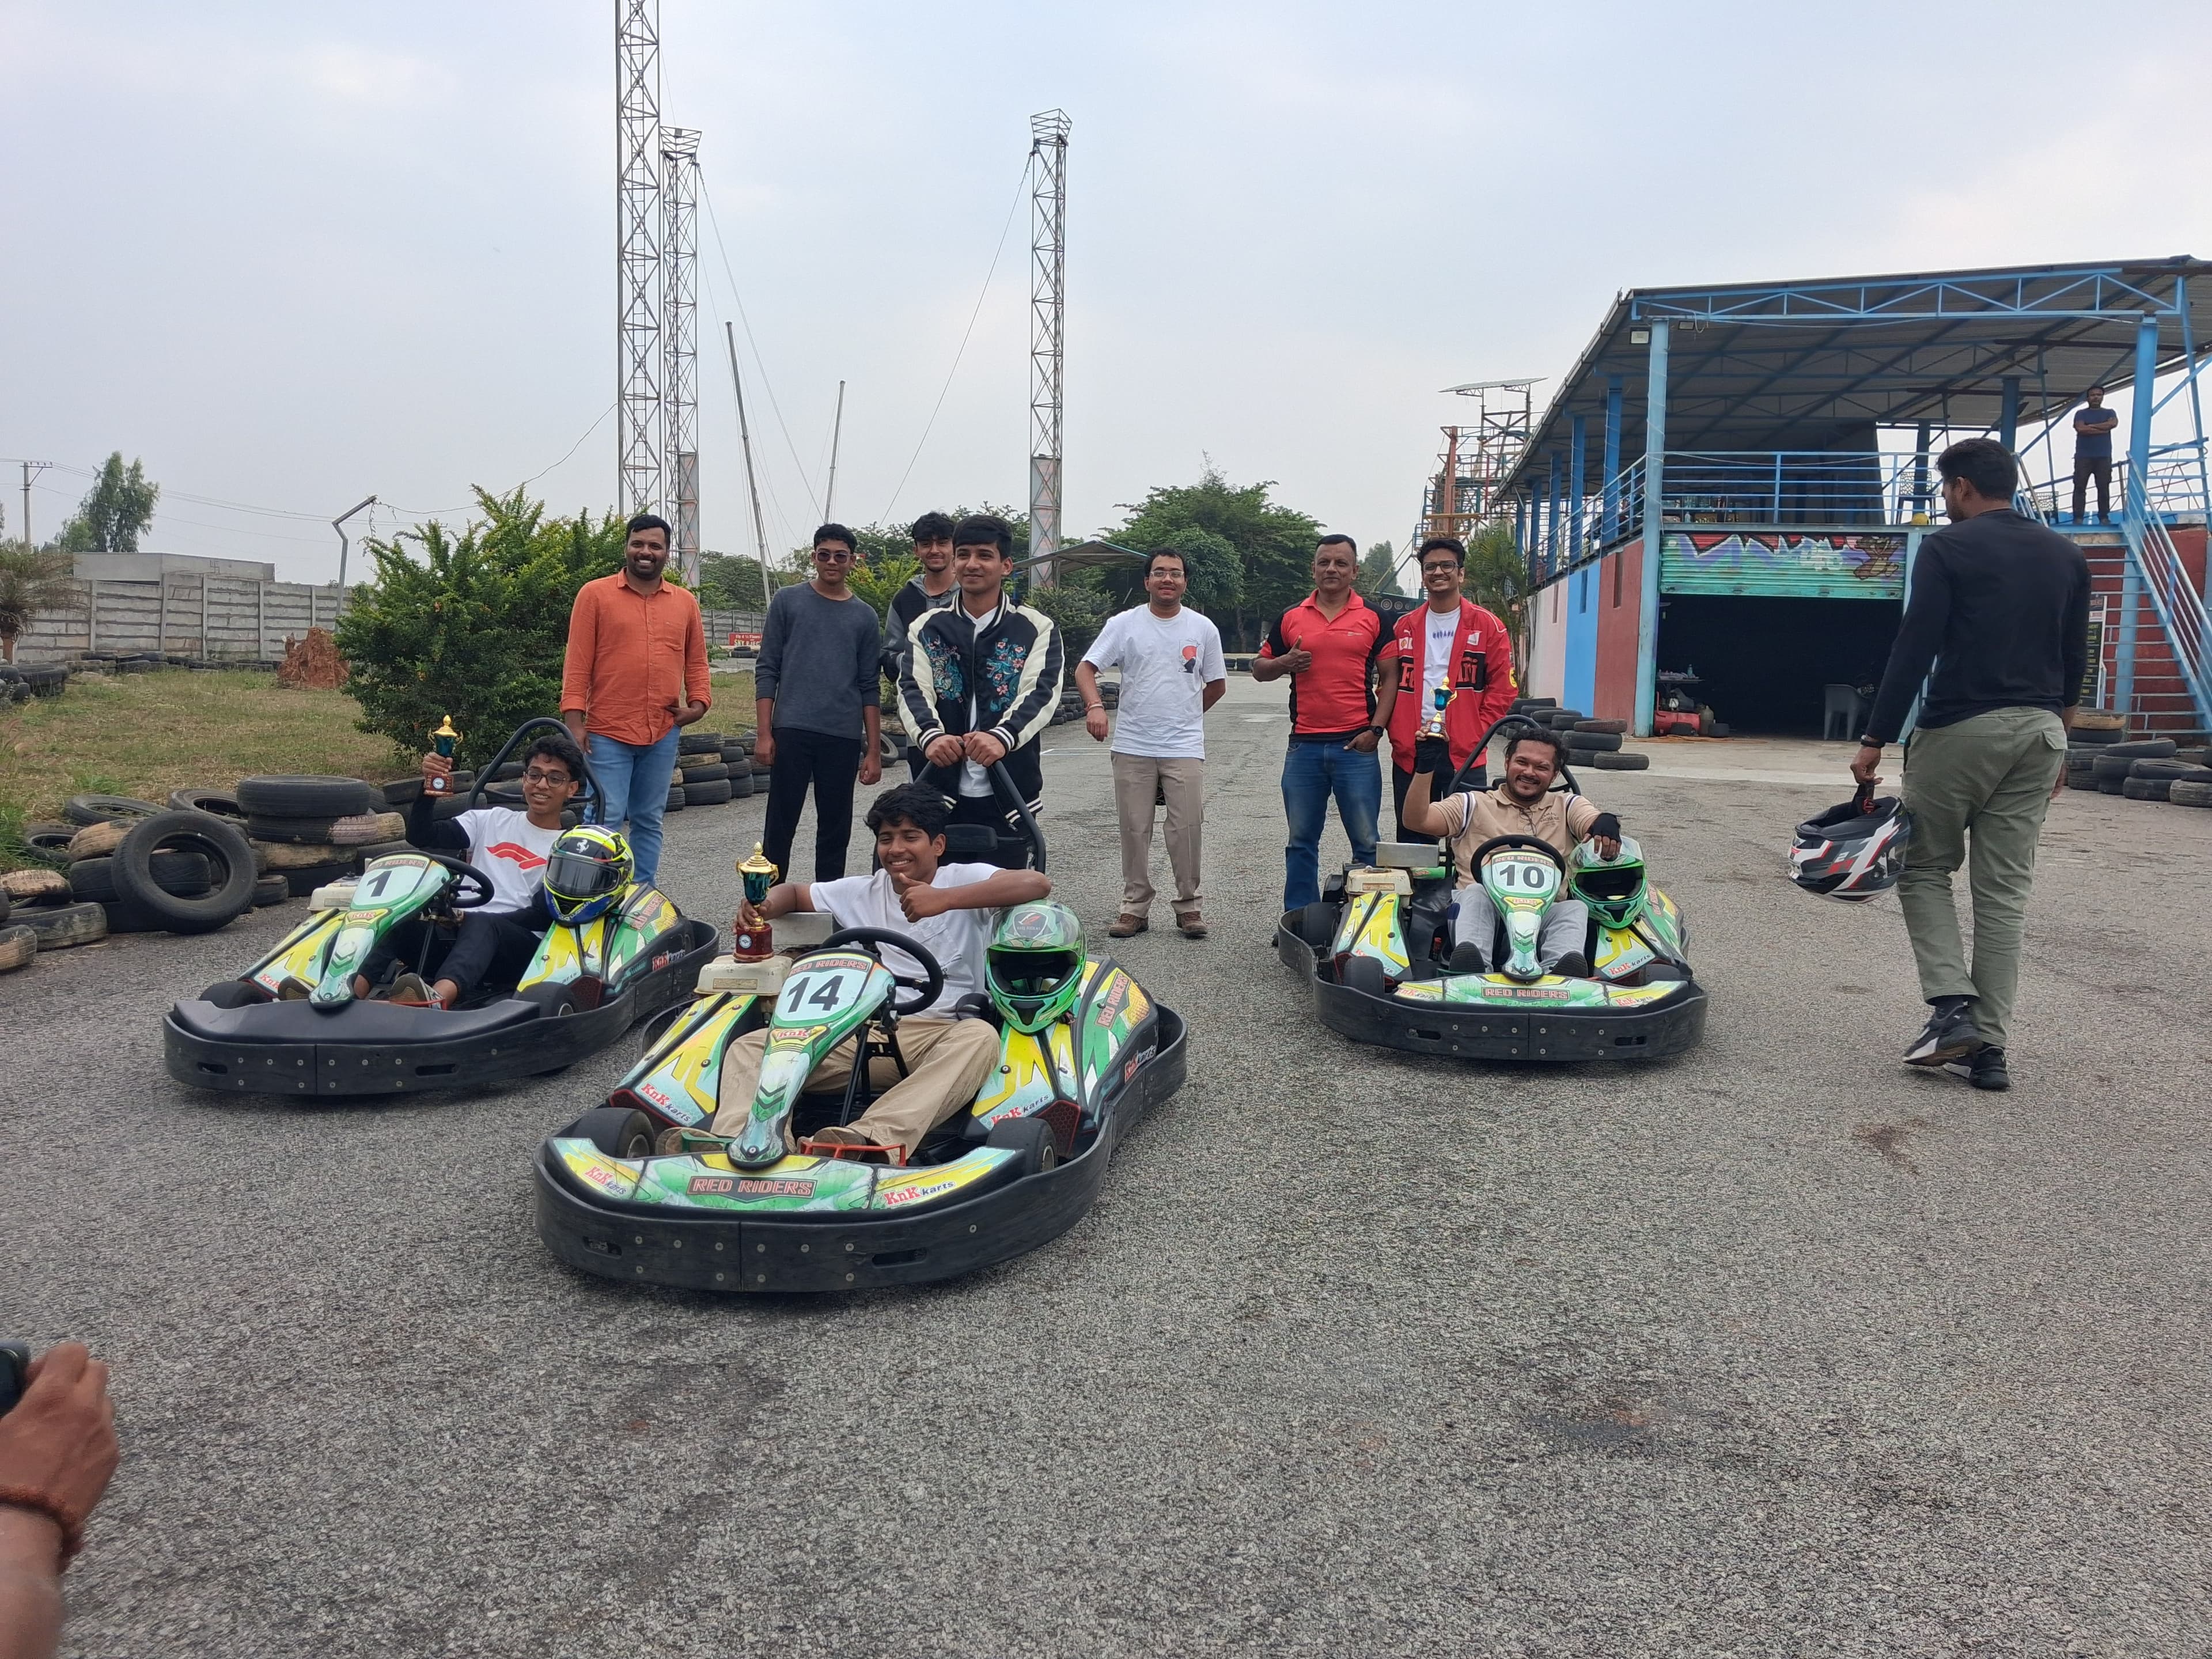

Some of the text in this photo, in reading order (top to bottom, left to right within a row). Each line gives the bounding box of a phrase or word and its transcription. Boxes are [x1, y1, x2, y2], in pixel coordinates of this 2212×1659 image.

[366, 870, 392, 897] 1
[1499, 864, 1545, 889] 10
[789, 963, 812, 975] RED
[815, 959, 868, 970] RIDERS
[1608, 954, 1651, 975] KnK karts
[787, 975, 845, 1013] 14
[1097, 974, 1130, 1027] RED RIDERS
[1485, 988, 1568, 999] RED RIDERS
[640, 1083, 691, 1122] KnK karts
[1022, 1094, 1050, 1113] karts
[584, 1165, 627, 1195] KnK karts
[692, 1179, 813, 1195] RED RIDERS
[883, 1181, 955, 1206] KnK karts
